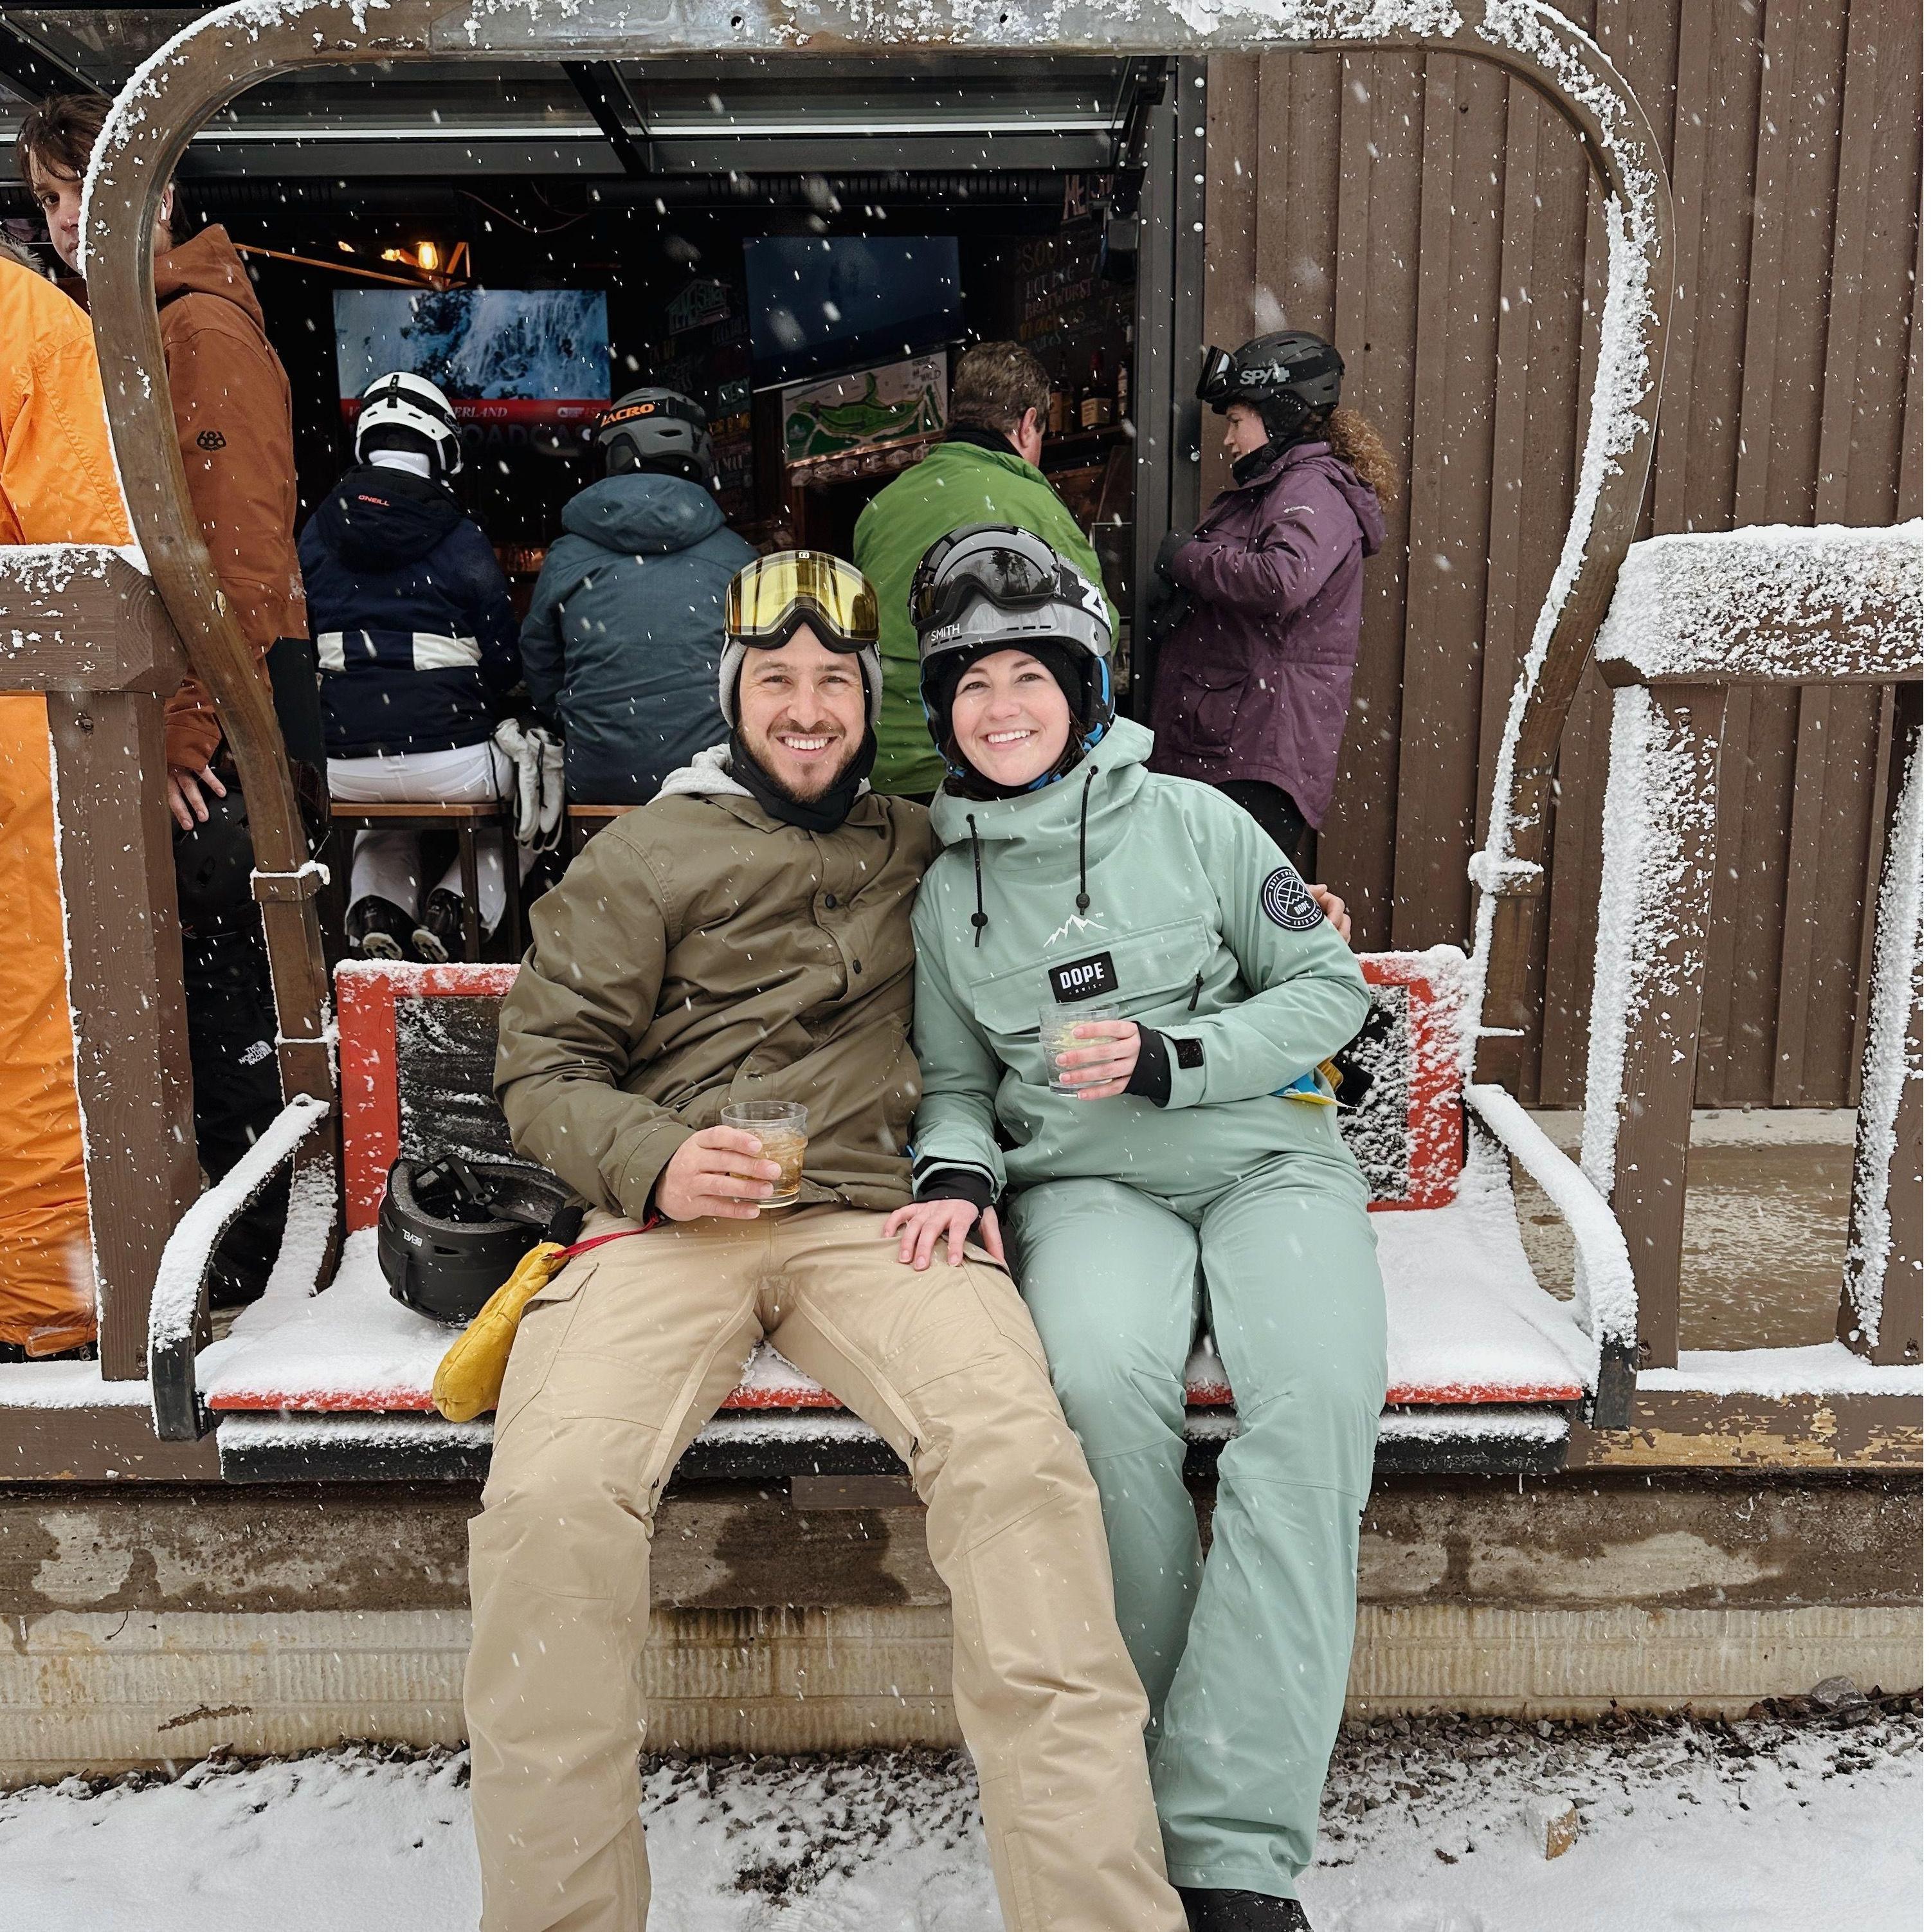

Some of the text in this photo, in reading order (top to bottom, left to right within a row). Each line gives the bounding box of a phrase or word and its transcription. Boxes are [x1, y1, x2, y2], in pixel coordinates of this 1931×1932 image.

[452, 406, 508, 418] ERLAND
[930, 623, 960, 642] SMITH
[1293, 900, 1311, 915] DOPE
[1059, 961, 1105, 990] DOPE
[238, 1047, 262, 1065] NORTH
[402, 1228, 423, 1247] BEVEL
